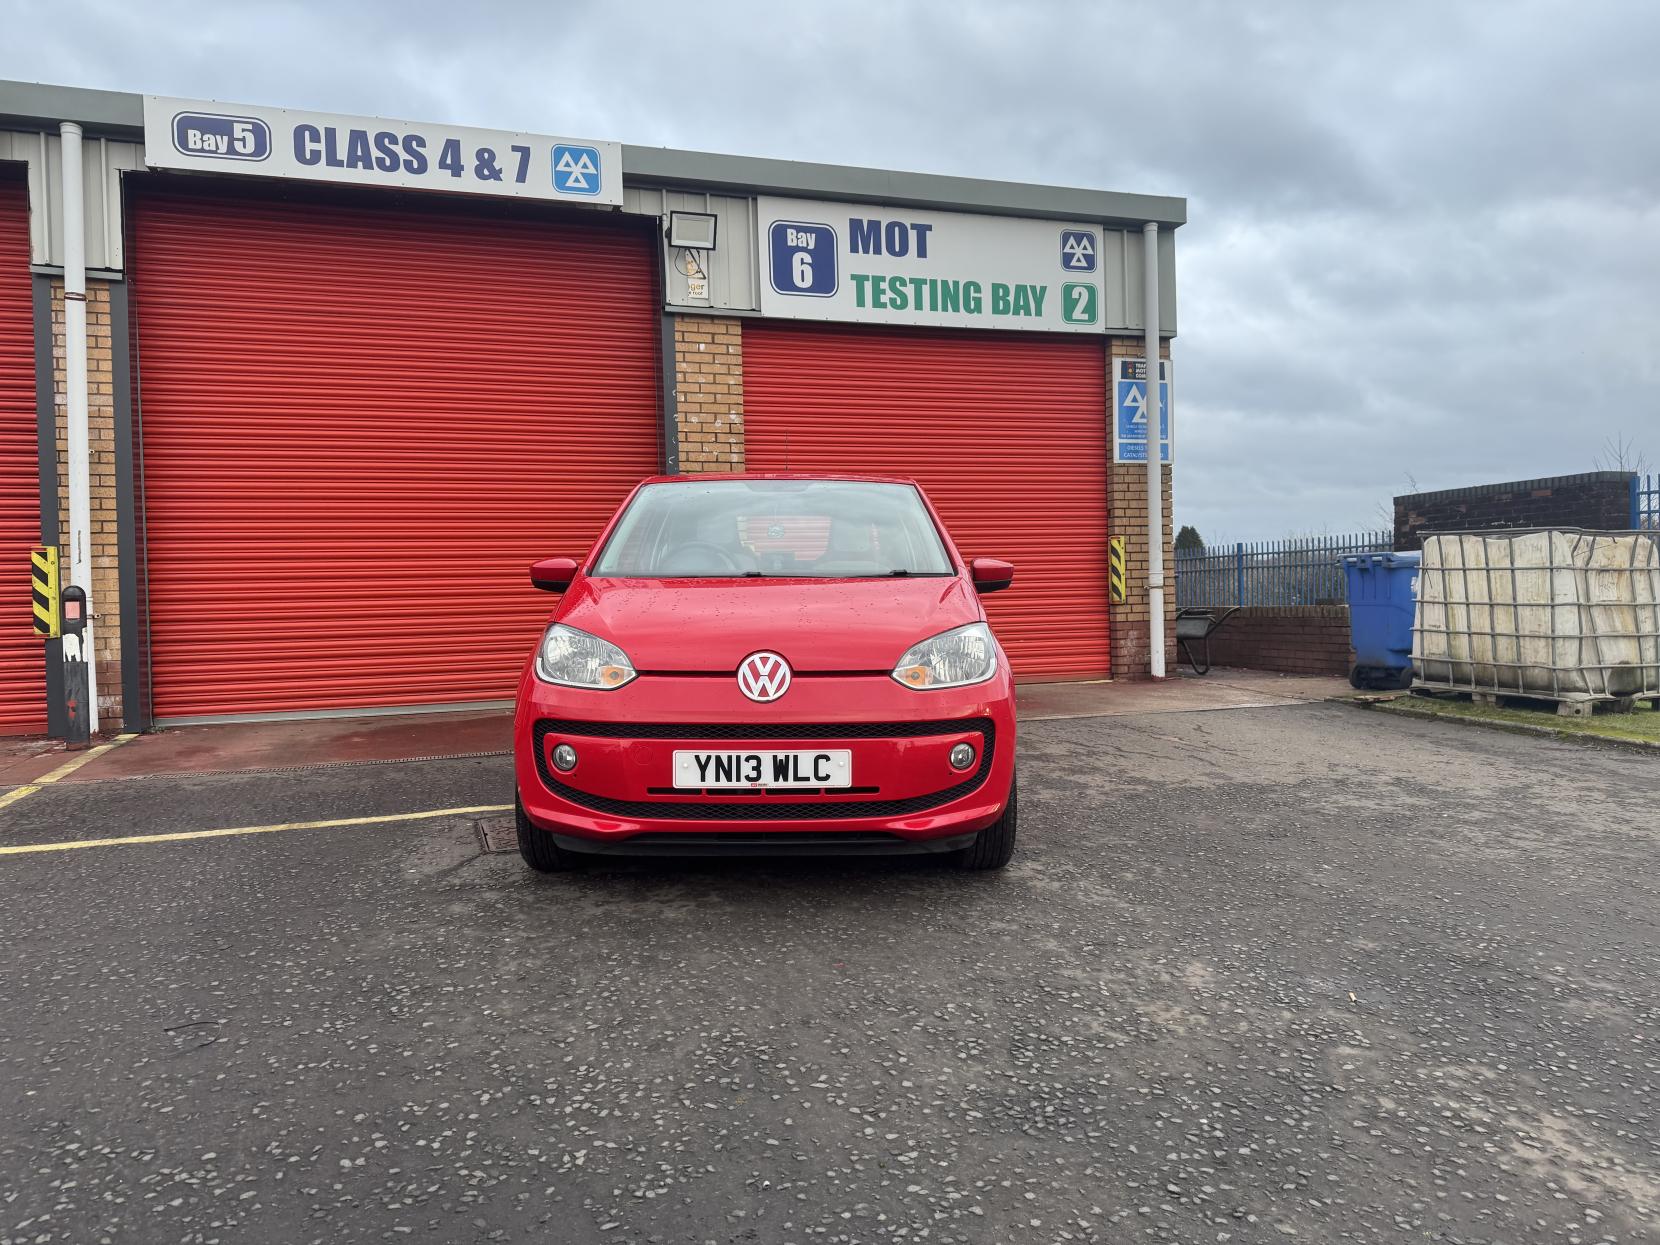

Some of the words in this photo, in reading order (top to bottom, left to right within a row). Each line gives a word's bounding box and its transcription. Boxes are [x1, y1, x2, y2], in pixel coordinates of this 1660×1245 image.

[187, 129, 228, 154] Bay
[233, 122, 255, 154] 5
[293, 123, 428, 175] CLASS
[438, 138, 464, 178] 4
[474, 147, 503, 182] &
[511, 144, 531, 184] 7
[787, 228, 816, 250] Bay
[849, 217, 933, 259] MOT
[792, 251, 813, 289] 6
[850, 273, 983, 315] TESTING
[991, 282, 1047, 317] BAY
[1071, 286, 1089, 320] 2
[694, 755, 762, 783] YN13
[772, 754, 831, 782] WLC
